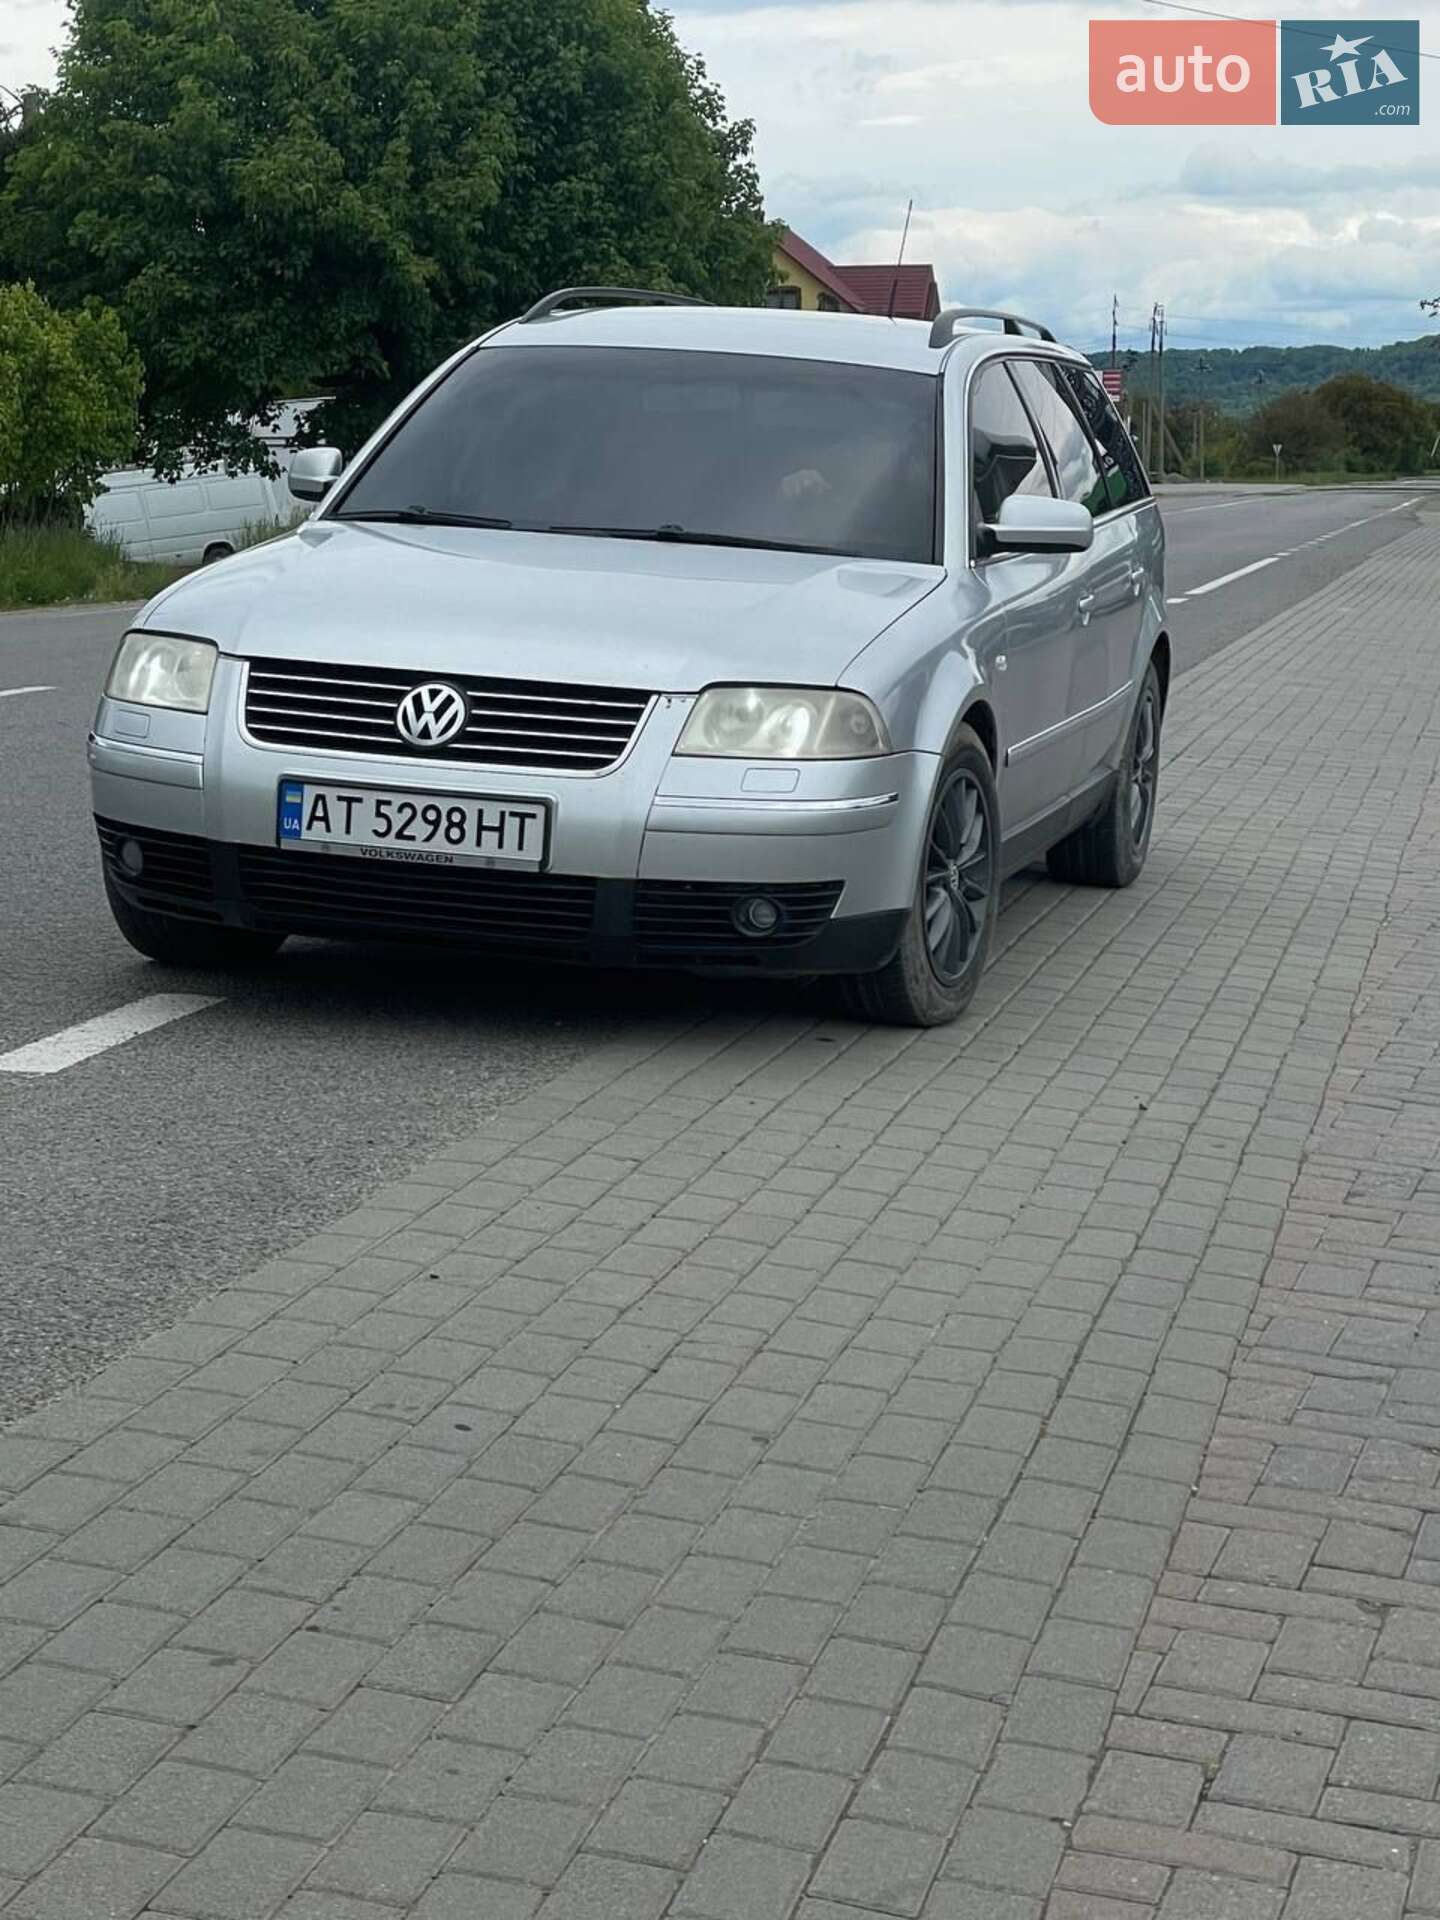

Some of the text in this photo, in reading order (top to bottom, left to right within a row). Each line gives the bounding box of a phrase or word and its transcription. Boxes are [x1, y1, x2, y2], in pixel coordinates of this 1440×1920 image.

[283, 816, 300, 830] UA
[305, 793, 537, 851] AT 5298 HT
[359, 847, 455, 865] VOLKSWAGEN
